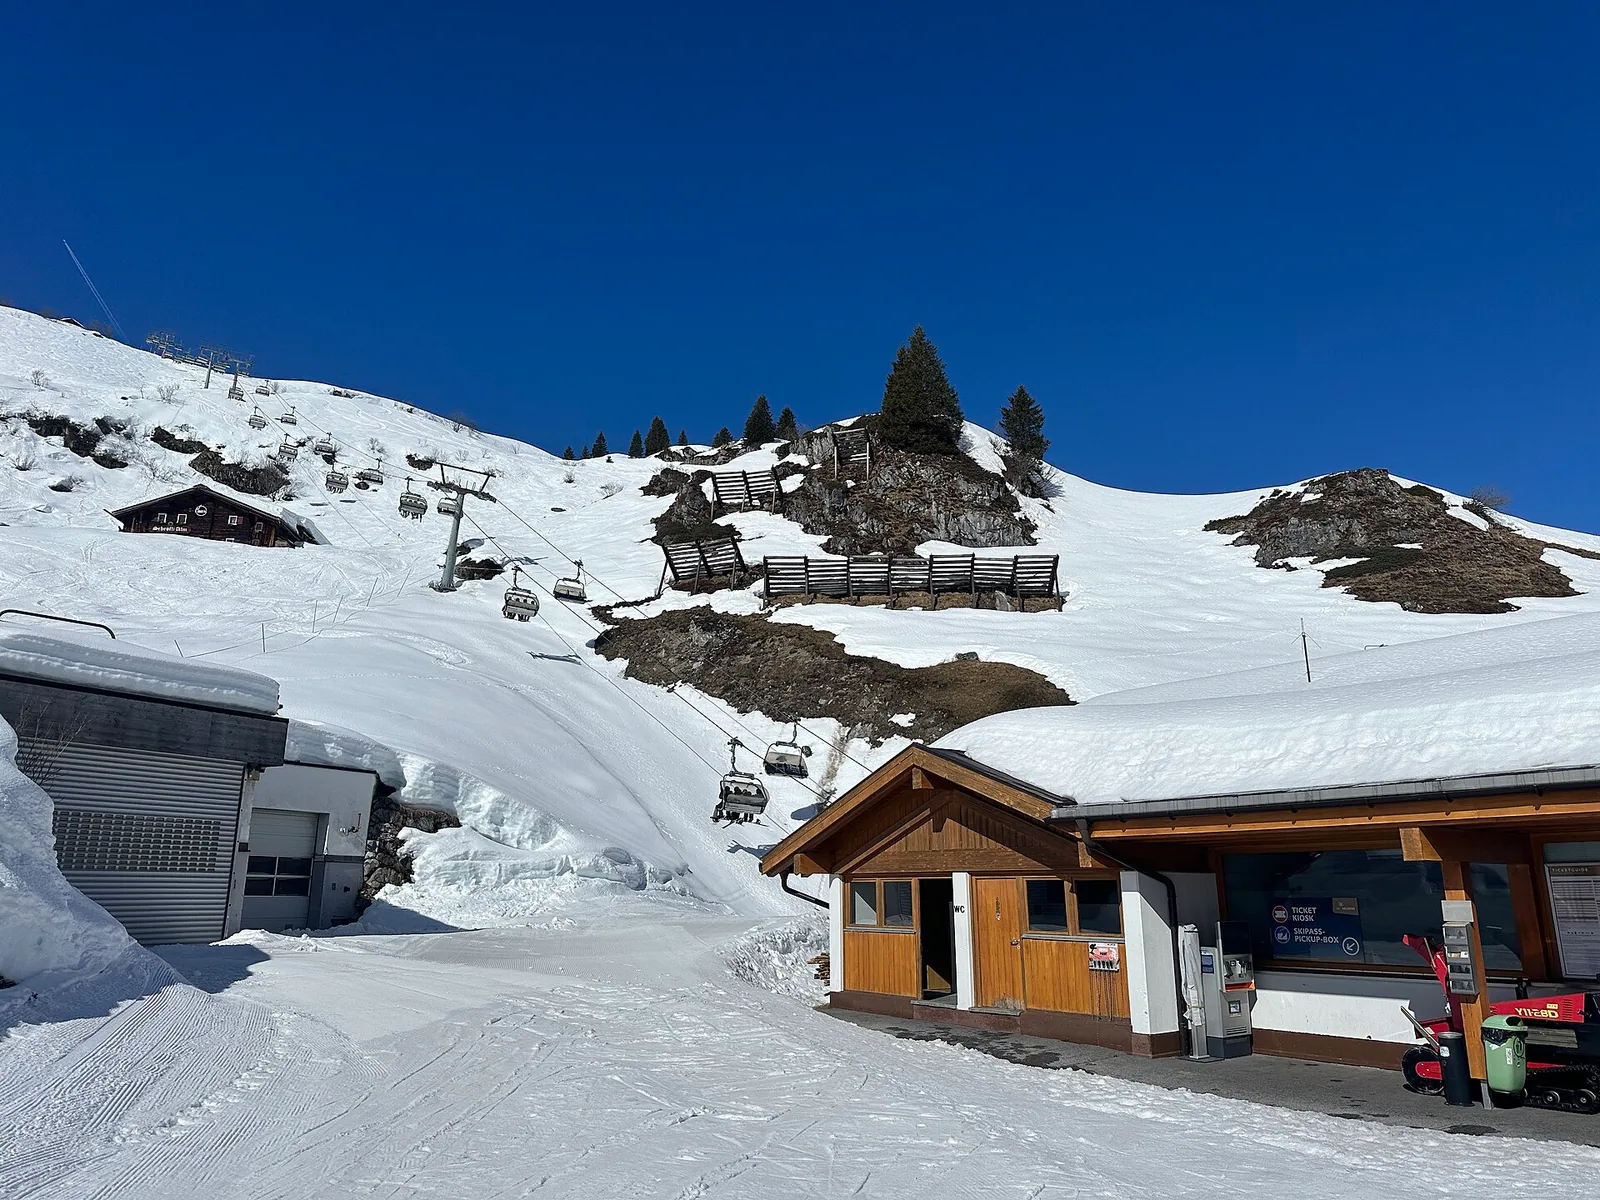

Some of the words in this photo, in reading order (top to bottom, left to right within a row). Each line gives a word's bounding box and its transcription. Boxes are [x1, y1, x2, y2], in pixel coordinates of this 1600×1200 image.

[953, 905, 965, 914] WC
[1291, 906, 1317, 914] TICKET
[1292, 914, 1315, 922] KIOSK
[1293, 927, 1326, 935] SKIPASS-
[1294, 935, 1340, 944] PICKUP-BOX
